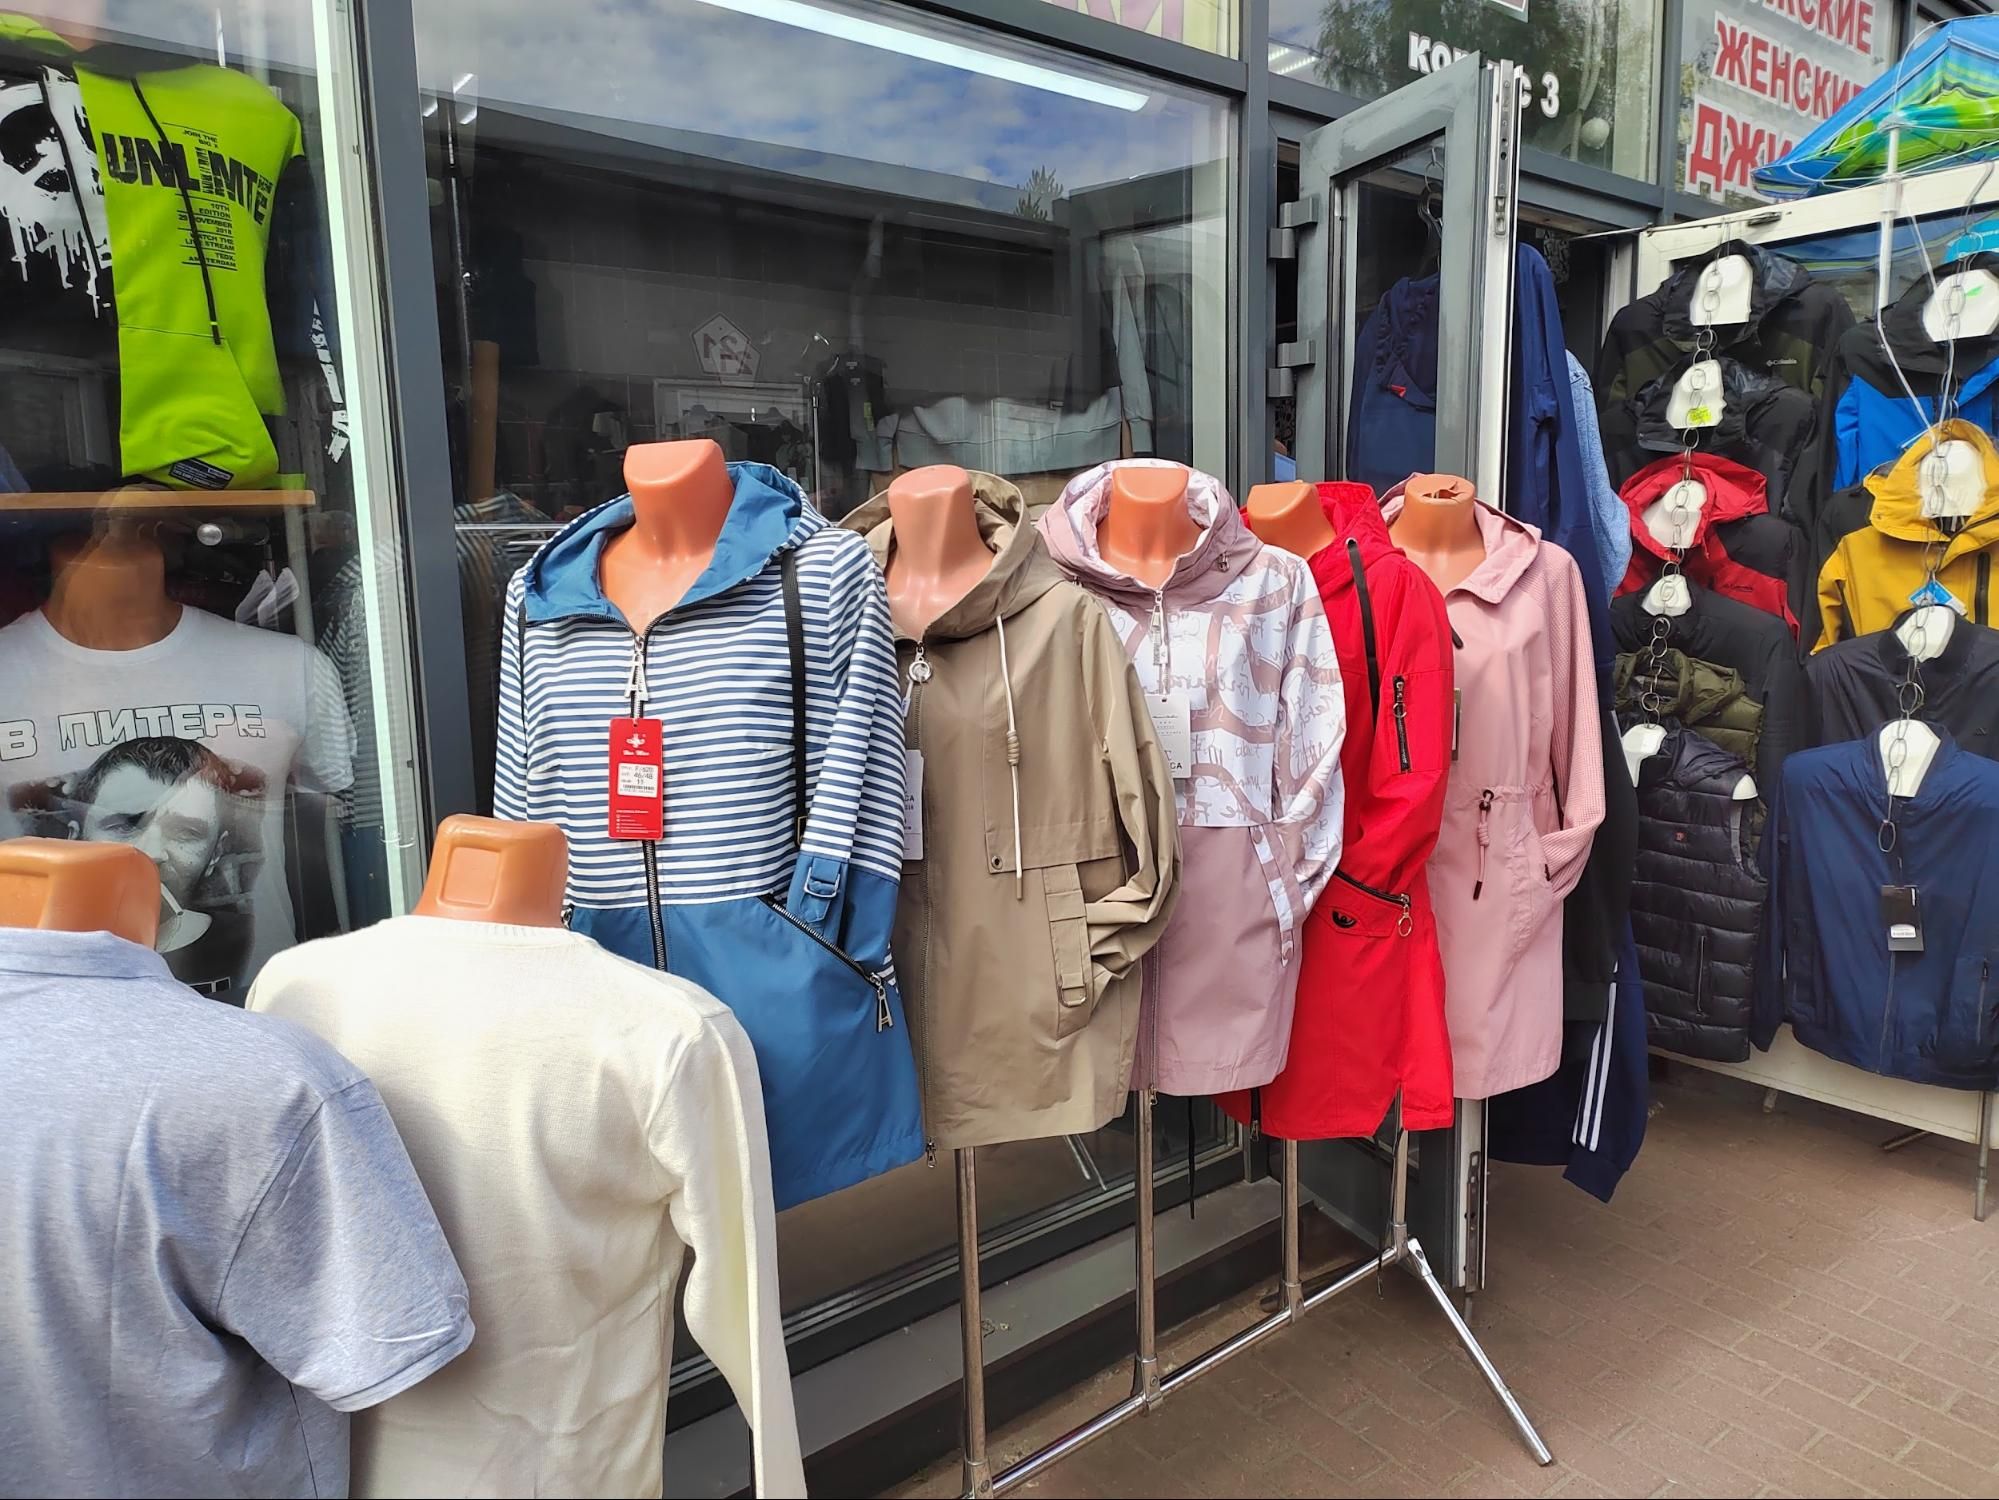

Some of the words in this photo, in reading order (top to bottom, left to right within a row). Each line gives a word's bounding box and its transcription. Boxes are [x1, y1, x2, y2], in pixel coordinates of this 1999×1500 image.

[1540, 71, 1560, 119] 3
[199, 208, 231, 218] EDITION
[205, 240, 235, 251] STREAM
[58, 703, 266, 751] ПИТЕРЕ
